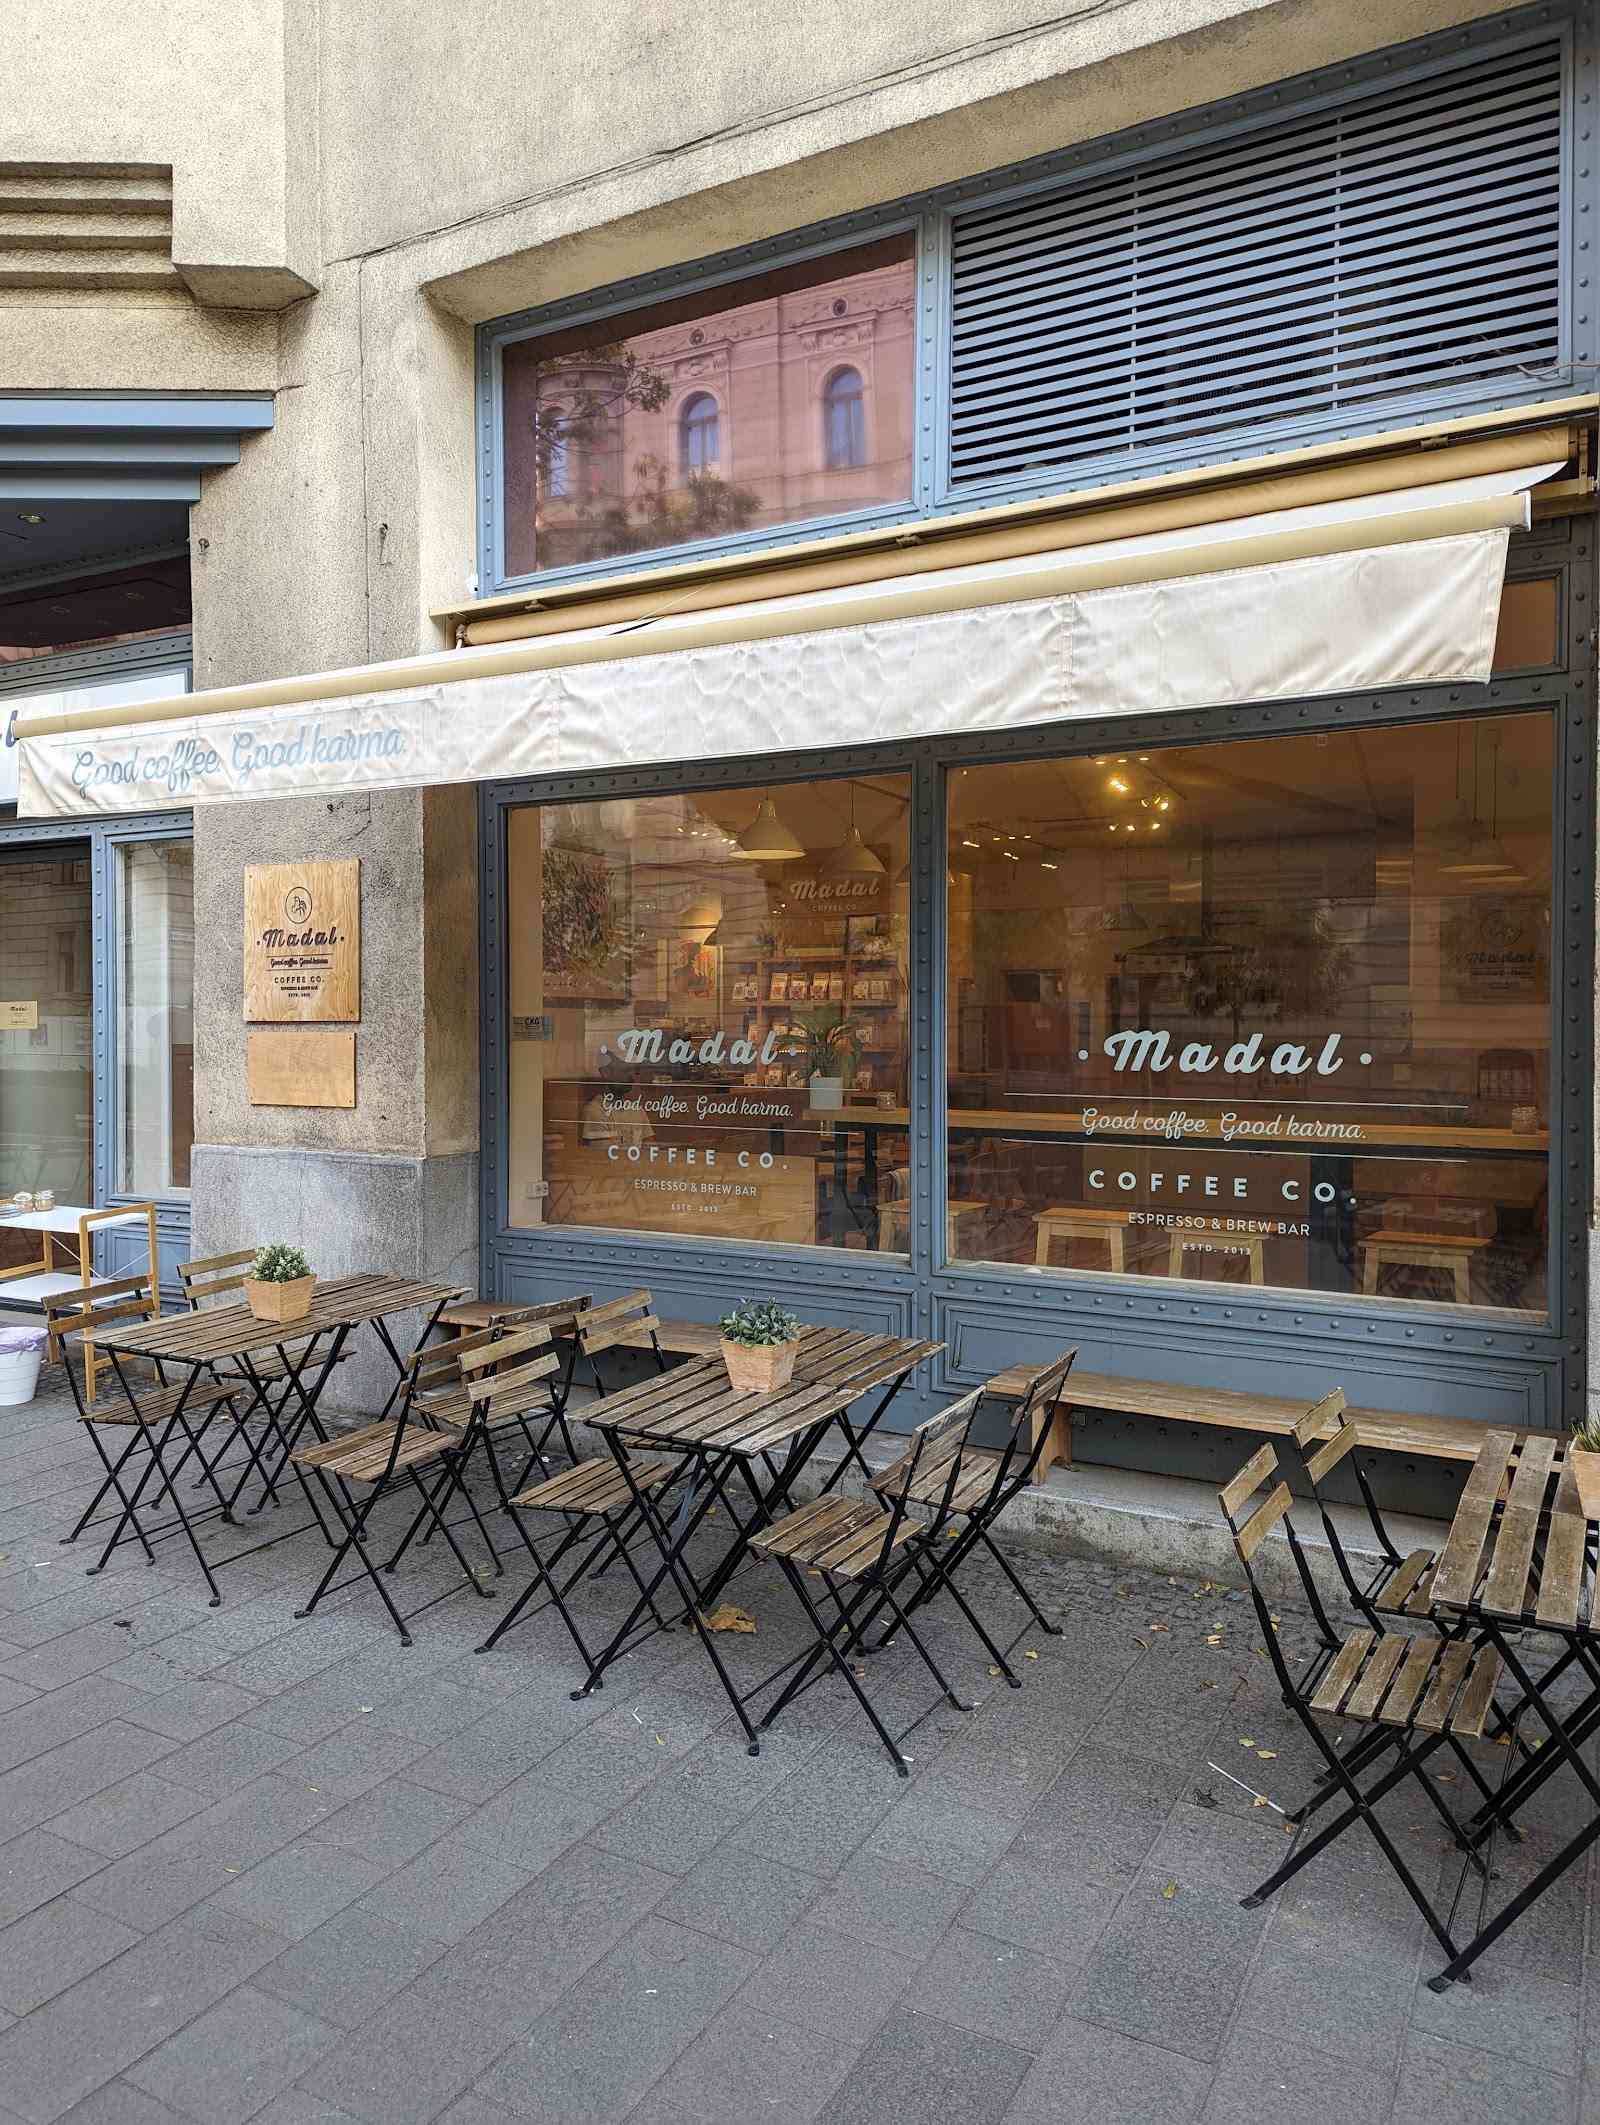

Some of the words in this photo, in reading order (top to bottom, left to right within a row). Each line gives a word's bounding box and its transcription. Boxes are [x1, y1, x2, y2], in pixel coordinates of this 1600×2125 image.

[72, 746, 139, 799] Good
[231, 726, 306, 785] Good
[790, 879, 879, 899] Madal
[262, 927, 337, 948] Madal
[274, 976, 306, 984] COFFEE
[617, 1028, 779, 1065] Madal
[1103, 1029, 1344, 1076] Madal
[602, 1092, 643, 1113] Good
[644, 1095, 690, 1119] coffee.
[696, 1096, 738, 1120] Good
[740, 1097, 794, 1117] karma.
[1081, 1107, 1138, 1136] Good
[1143, 1111, 1210, 1140] coffee.
[1219, 1111, 1283, 1142] Good
[1286, 1114, 1368, 1140] karma.
[607, 1145, 716, 1166] COFFEE
[737, 1151, 788, 1170] CO.
[634, 1179, 688, 1193] ESPRESSO
[690, 1184, 698, 1193] &
[700, 1183, 732, 1195] BREW
[735, 1186, 758, 1197] BAR
[1088, 1169, 1248, 1198] COFFEE
[1281, 1180, 1357, 1204] CO.
[1128, 1211, 1206, 1229] ESPRESSO
[1211, 1217, 1222, 1230] &
[1226, 1219, 1272, 1234] BREW
[1278, 1223, 1310, 1237] BAR
